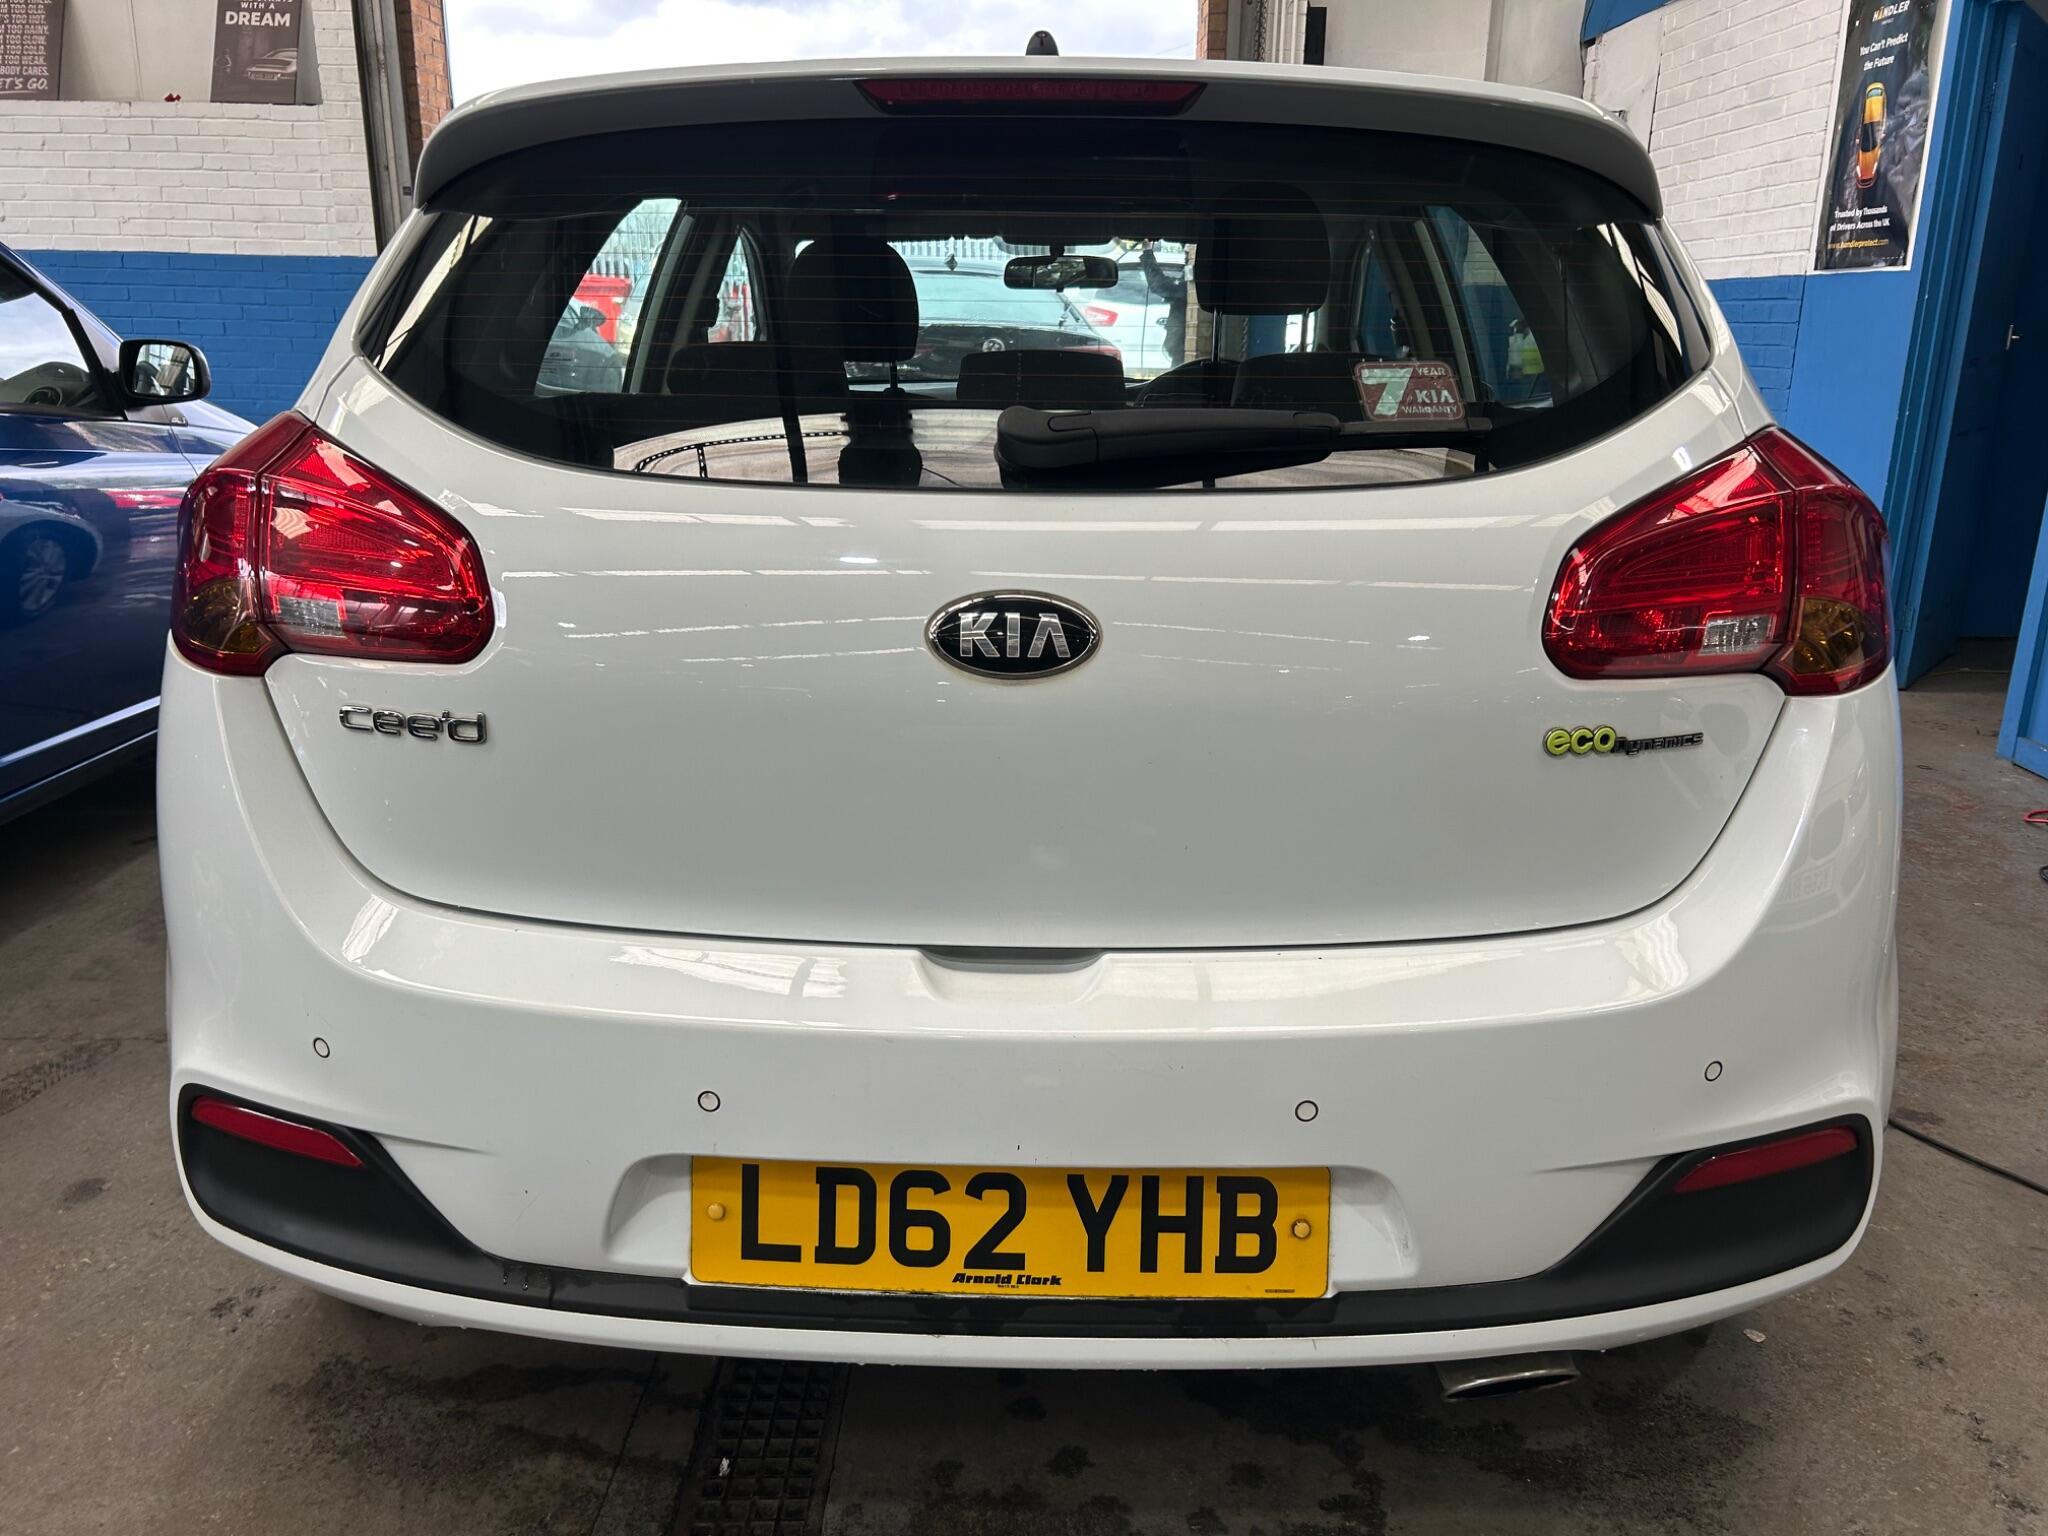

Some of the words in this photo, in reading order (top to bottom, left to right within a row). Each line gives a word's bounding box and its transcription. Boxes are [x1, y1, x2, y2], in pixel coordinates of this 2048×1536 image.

[10, 4, 26, 13] TOO
[240, 1, 265, 9] WITH
[268, 2, 276, 10] A
[11, 14, 27, 24] TOO
[225, 10, 291, 27] DREAM
[6, 24, 22, 34] TOO
[6, 34, 21, 44] TOO
[1860, 46, 1870, 56] You
[1886, 32, 1909, 48] Predict
[5, 44, 21, 54] TOO
[4, 55, 20, 64] TOO
[1874, 55, 1895, 68] Future
[0, 65, 21, 75] BODY
[27, 77, 48, 90] GO.
[1834, 209, 1855, 219] Trusted
[1856, 208, 1863, 217] by
[1837, 223, 1856, 231] Drivers
[1361, 367, 1413, 416] 7
[1415, 367, 1447, 377] YEAR
[1414, 389, 1456, 404] KIA
[1401, 405, 1458, 414] WARRANTY
[958, 612, 1072, 659] KIA
[339, 704, 488, 744] cee'd
[741, 1162, 1027, 1271] LD62
[1066, 1172, 1279, 1274] YHB
[952, 1272, 1013, 1284] Arnold
[1016, 1274, 1063, 1286] Clark
